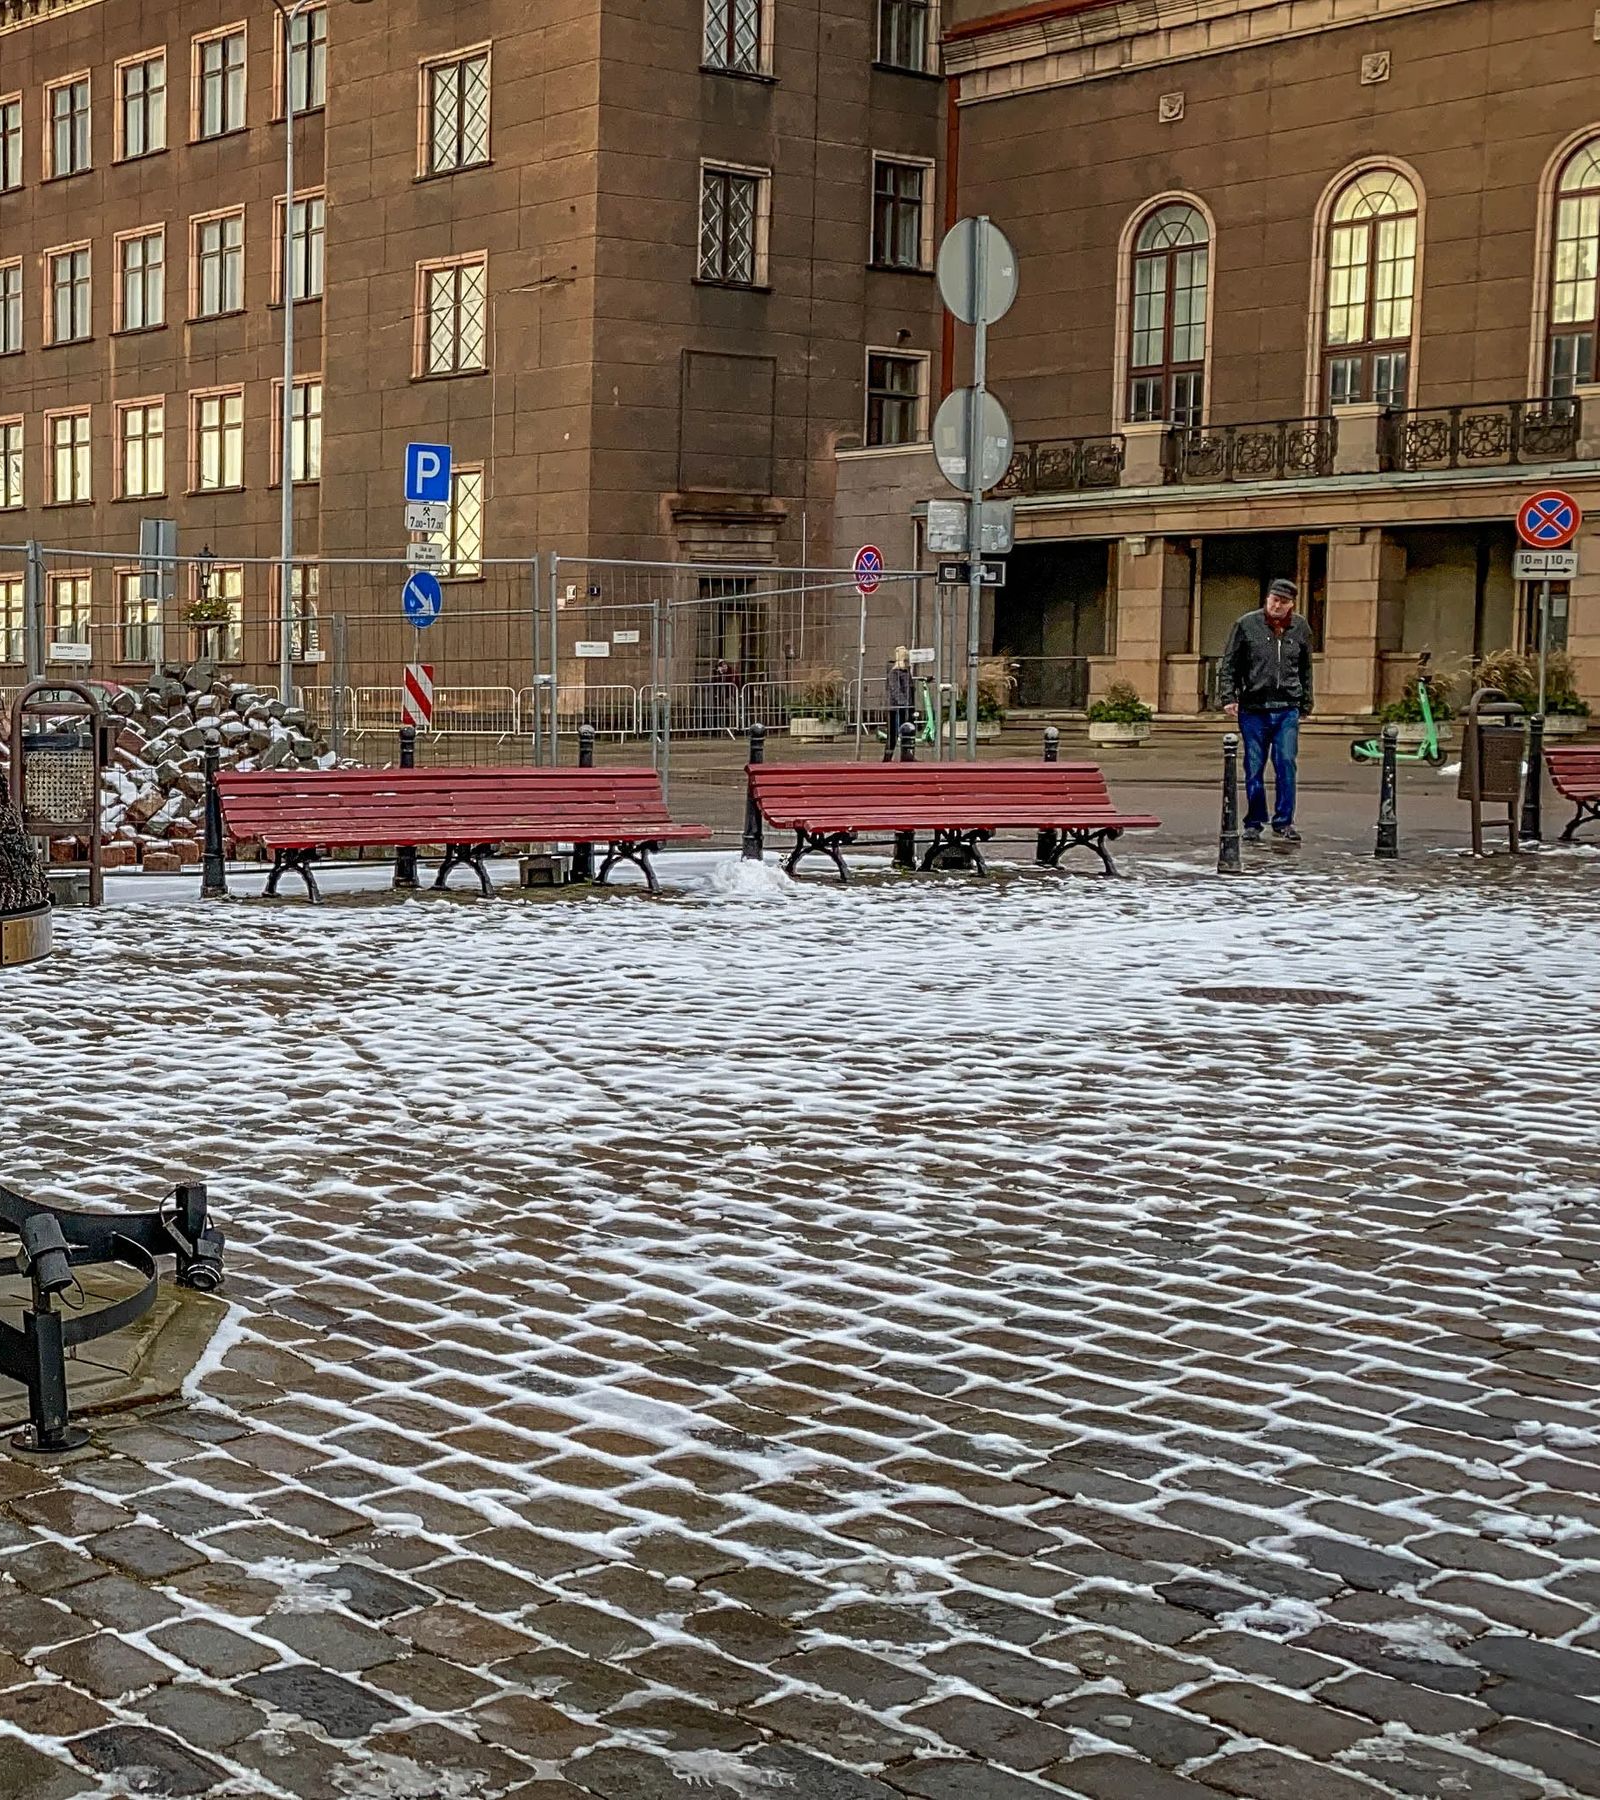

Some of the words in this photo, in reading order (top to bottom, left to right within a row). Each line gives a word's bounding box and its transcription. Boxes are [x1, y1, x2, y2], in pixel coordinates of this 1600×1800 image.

[416, 451, 441, 494] P
[1520, 554, 1532, 565] 10
[1551, 554, 1564, 565] 10
